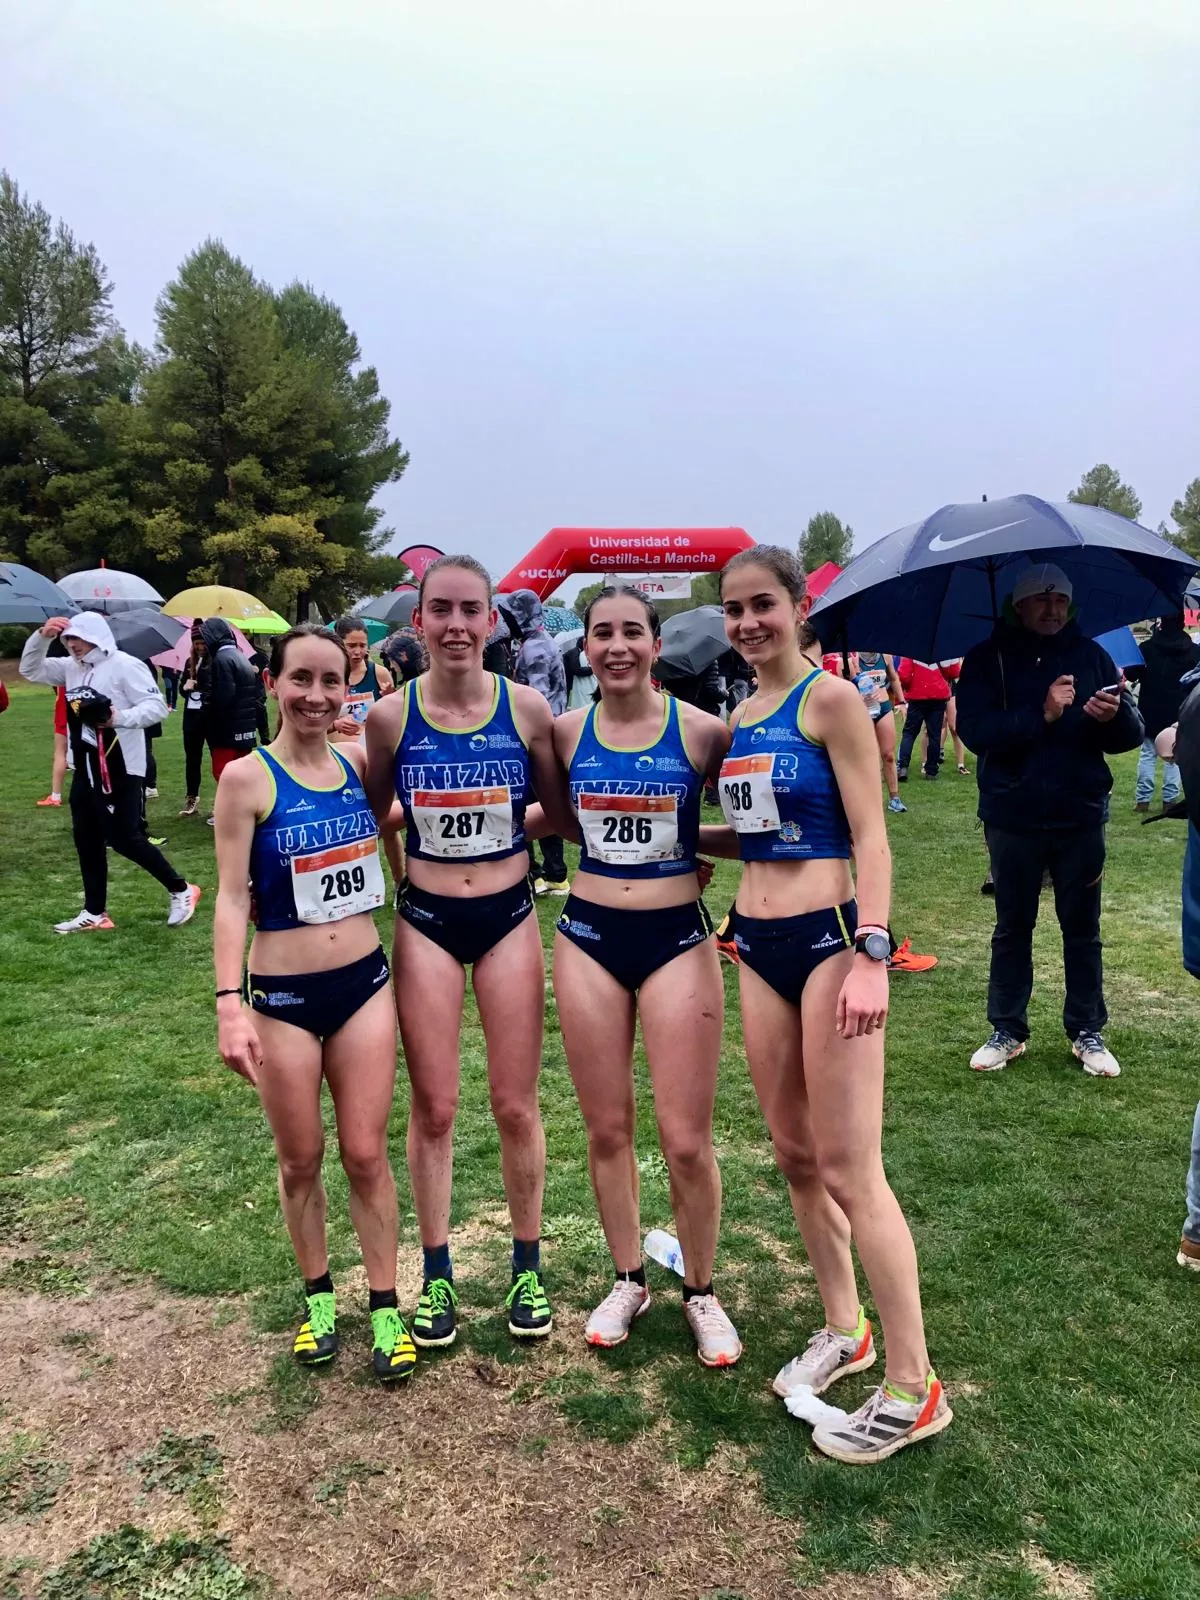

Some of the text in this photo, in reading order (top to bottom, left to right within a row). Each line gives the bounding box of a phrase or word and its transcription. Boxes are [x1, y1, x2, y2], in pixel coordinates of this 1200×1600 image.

[589, 536, 690, 548] Universidad de
[589, 552, 716, 565] Castilla-La Mancha
[528, 569, 567, 579] UCLM
[401, 760, 525, 792] UNIZAR
[439, 811, 485, 839] 287
[602, 816, 652, 844] 286
[320, 865, 365, 903] 289
[811, 937, 844, 950] MERCURY
